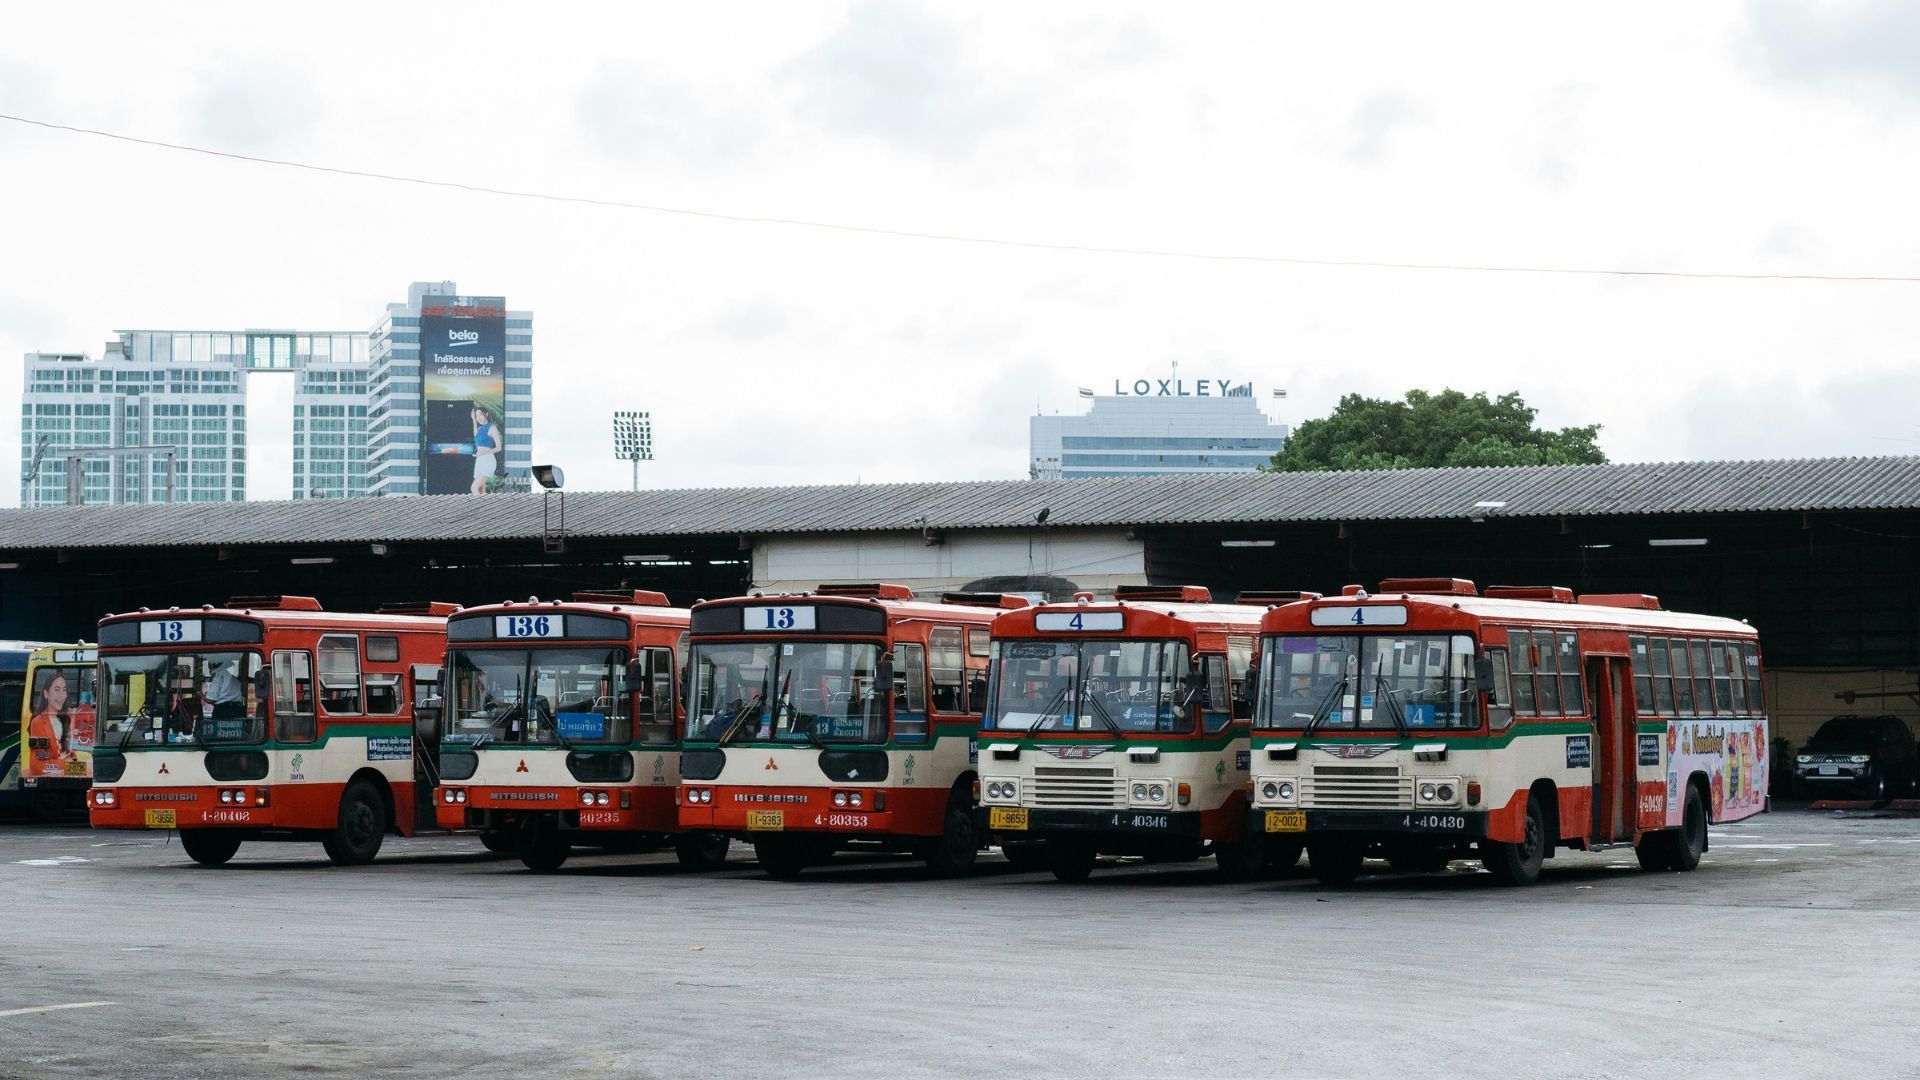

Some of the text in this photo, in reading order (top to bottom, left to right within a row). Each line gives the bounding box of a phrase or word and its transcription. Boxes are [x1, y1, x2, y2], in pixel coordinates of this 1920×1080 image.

[448, 329, 479, 341] beko
[1115, 379, 1231, 396] LOXLEY
[765, 608, 795, 629] 13
[1069, 613, 1084, 630] 4
[1351, 607, 1365, 625] 4
[157, 621, 184, 641] 13
[507, 616, 550, 637] 136
[72, 649, 85, 662] 47
[1412, 707, 1425, 725] 4
[815, 722, 829, 735] 13
[735, 794, 808, 802] MITSUBISHI
[750, 815, 782, 826] 11-9363
[993, 813, 1026, 824] 11-8653
